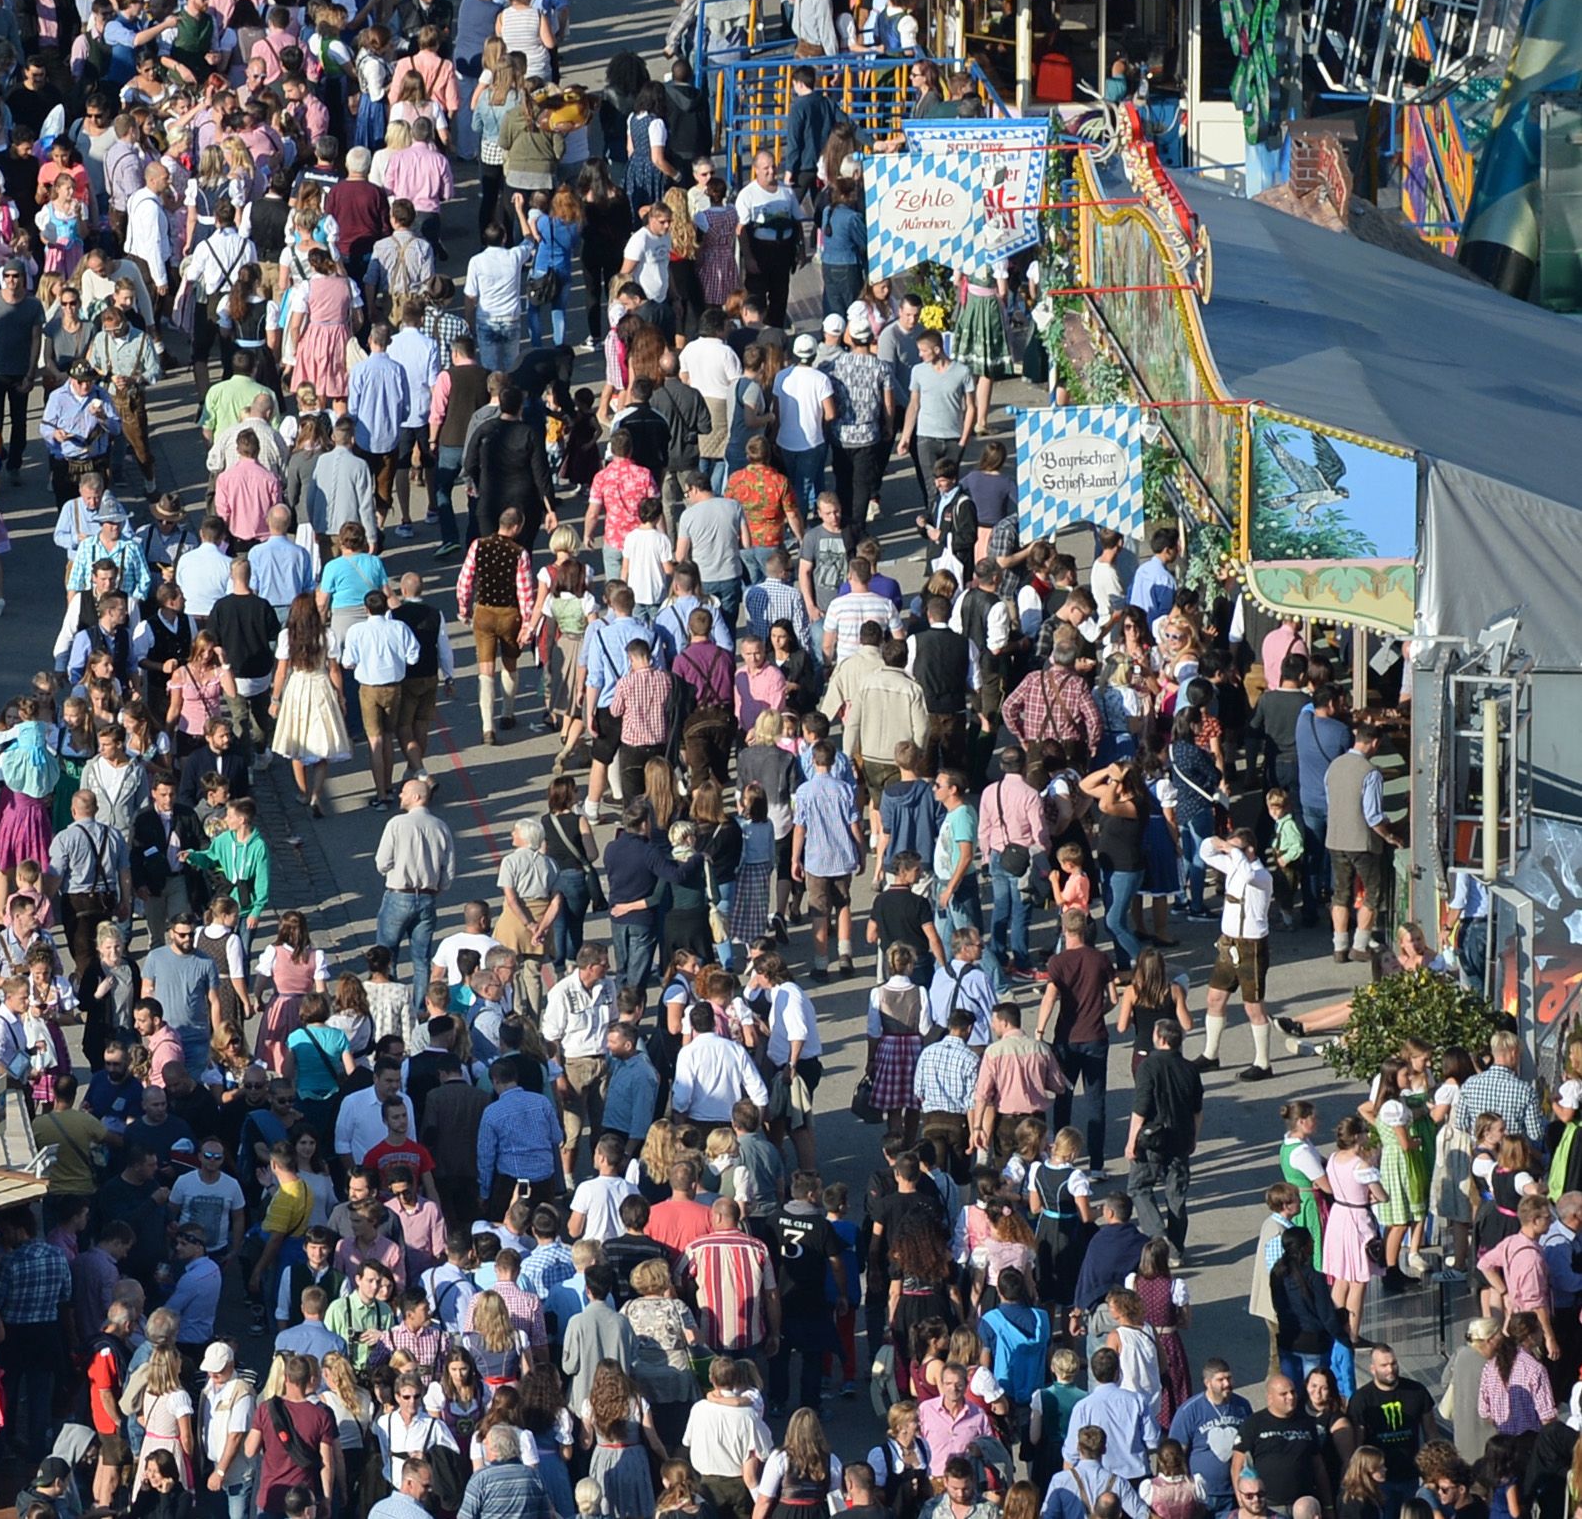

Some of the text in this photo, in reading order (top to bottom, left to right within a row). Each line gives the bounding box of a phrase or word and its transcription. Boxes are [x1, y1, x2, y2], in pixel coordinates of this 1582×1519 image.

[893, 187, 956, 214] Zehle
[1040, 448, 1116, 471] Bayrischer
[781, 1228, 805, 1259] 3
